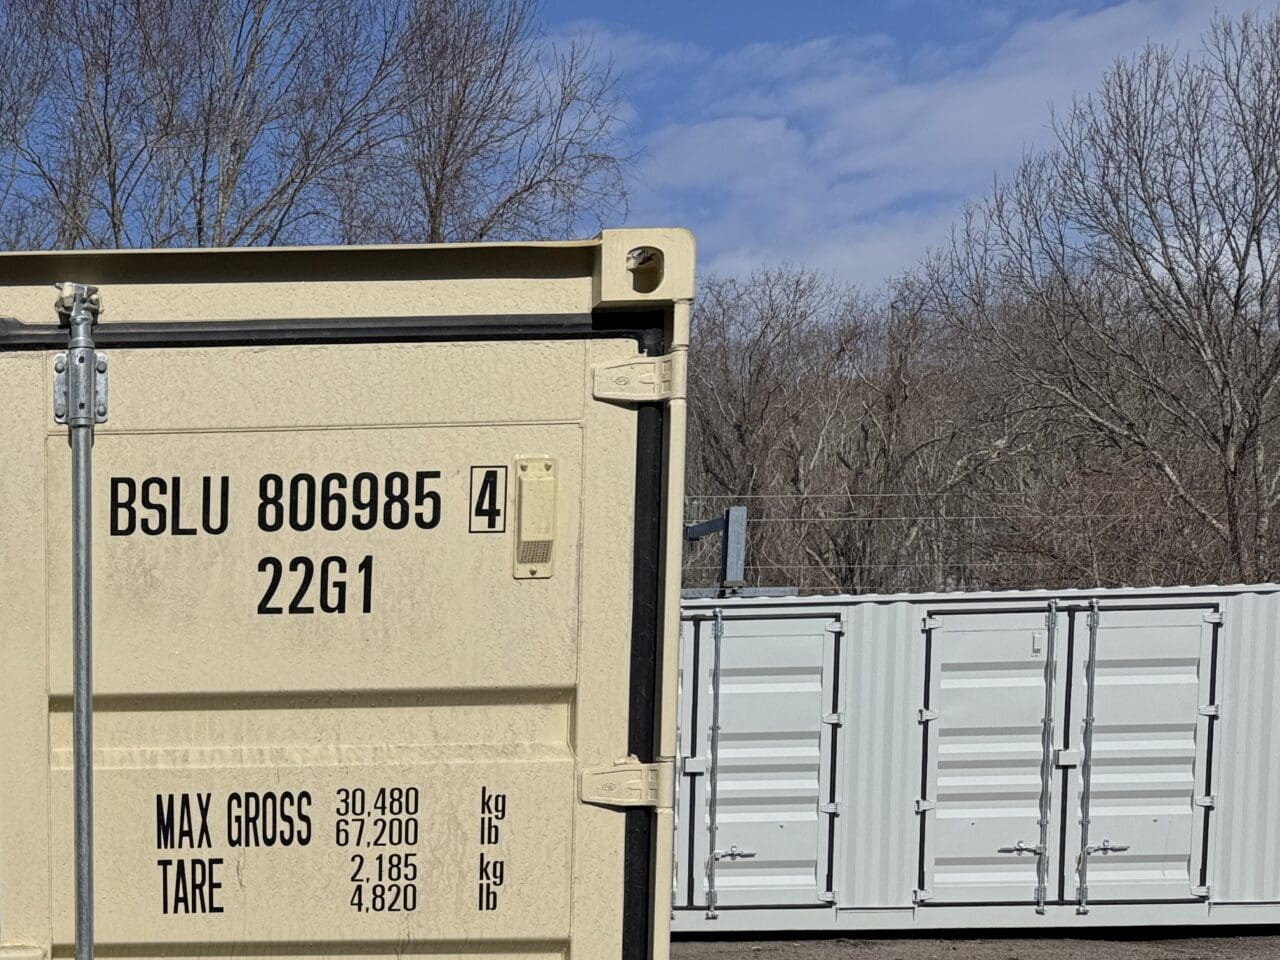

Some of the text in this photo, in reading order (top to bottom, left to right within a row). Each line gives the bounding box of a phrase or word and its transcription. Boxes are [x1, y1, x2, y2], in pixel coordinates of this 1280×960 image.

[110, 470, 501, 536] BSLU 806985 4
[257, 555, 374, 615] 22G1
[156, 786, 506, 849] MAX GROSS 30,480 kg
[335, 817, 499, 848] 67,200 lb
[157, 853, 504, 915] TARE 2,185 kg
[350, 883, 497, 913] 4,820 lb
